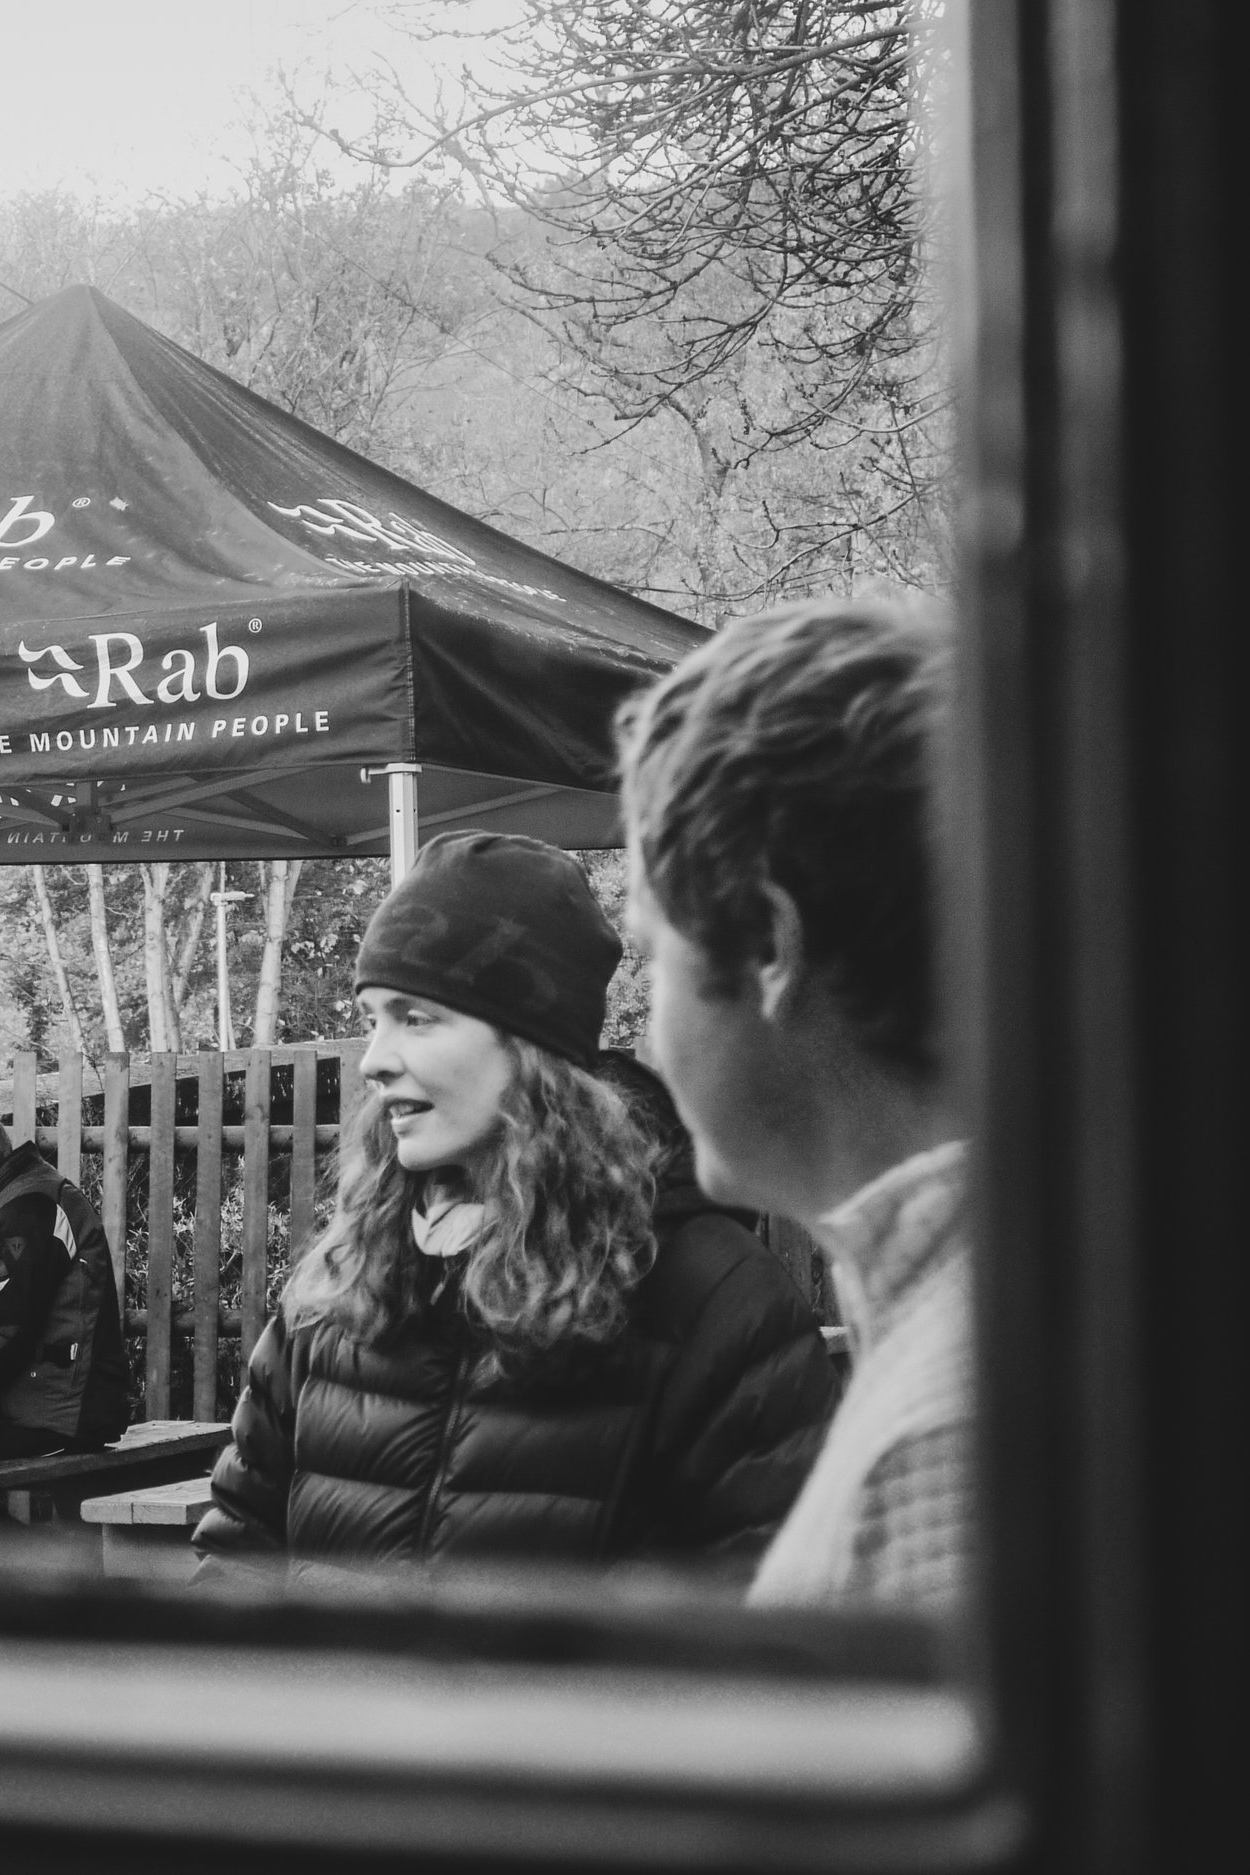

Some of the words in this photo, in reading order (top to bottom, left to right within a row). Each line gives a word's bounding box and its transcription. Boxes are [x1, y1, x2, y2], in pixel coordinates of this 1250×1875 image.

[317, 498, 477, 567] Rab
[86, 622, 250, 709] Rab
[29, 721, 196, 753] MOUNTAIN
[210, 710, 331, 739] PEOPLE
